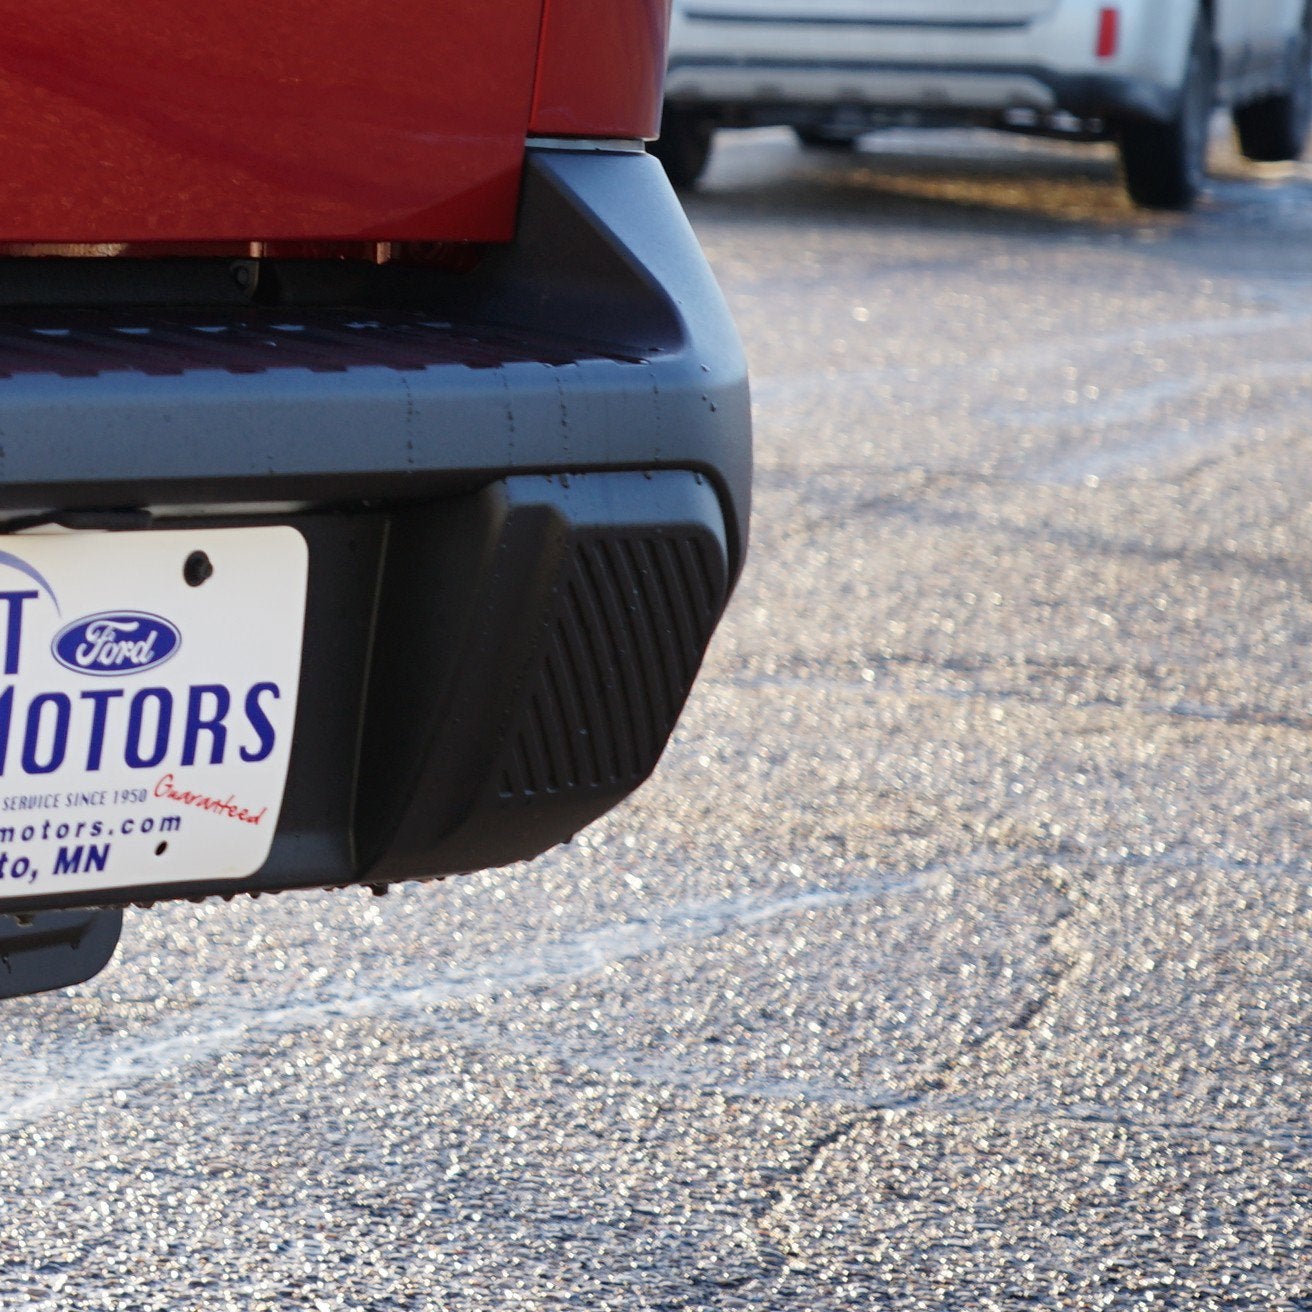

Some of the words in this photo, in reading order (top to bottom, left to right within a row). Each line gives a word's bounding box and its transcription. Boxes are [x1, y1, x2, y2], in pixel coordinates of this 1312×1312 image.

[76, 619, 155, 667] Ford
[3, 793, 60, 811] SERVICE
[65, 790, 107, 807] SINCE
[113, 788, 147, 805] 1950
[153, 773, 267, 826] Guaranteed
[52, 843, 111, 875] MN
